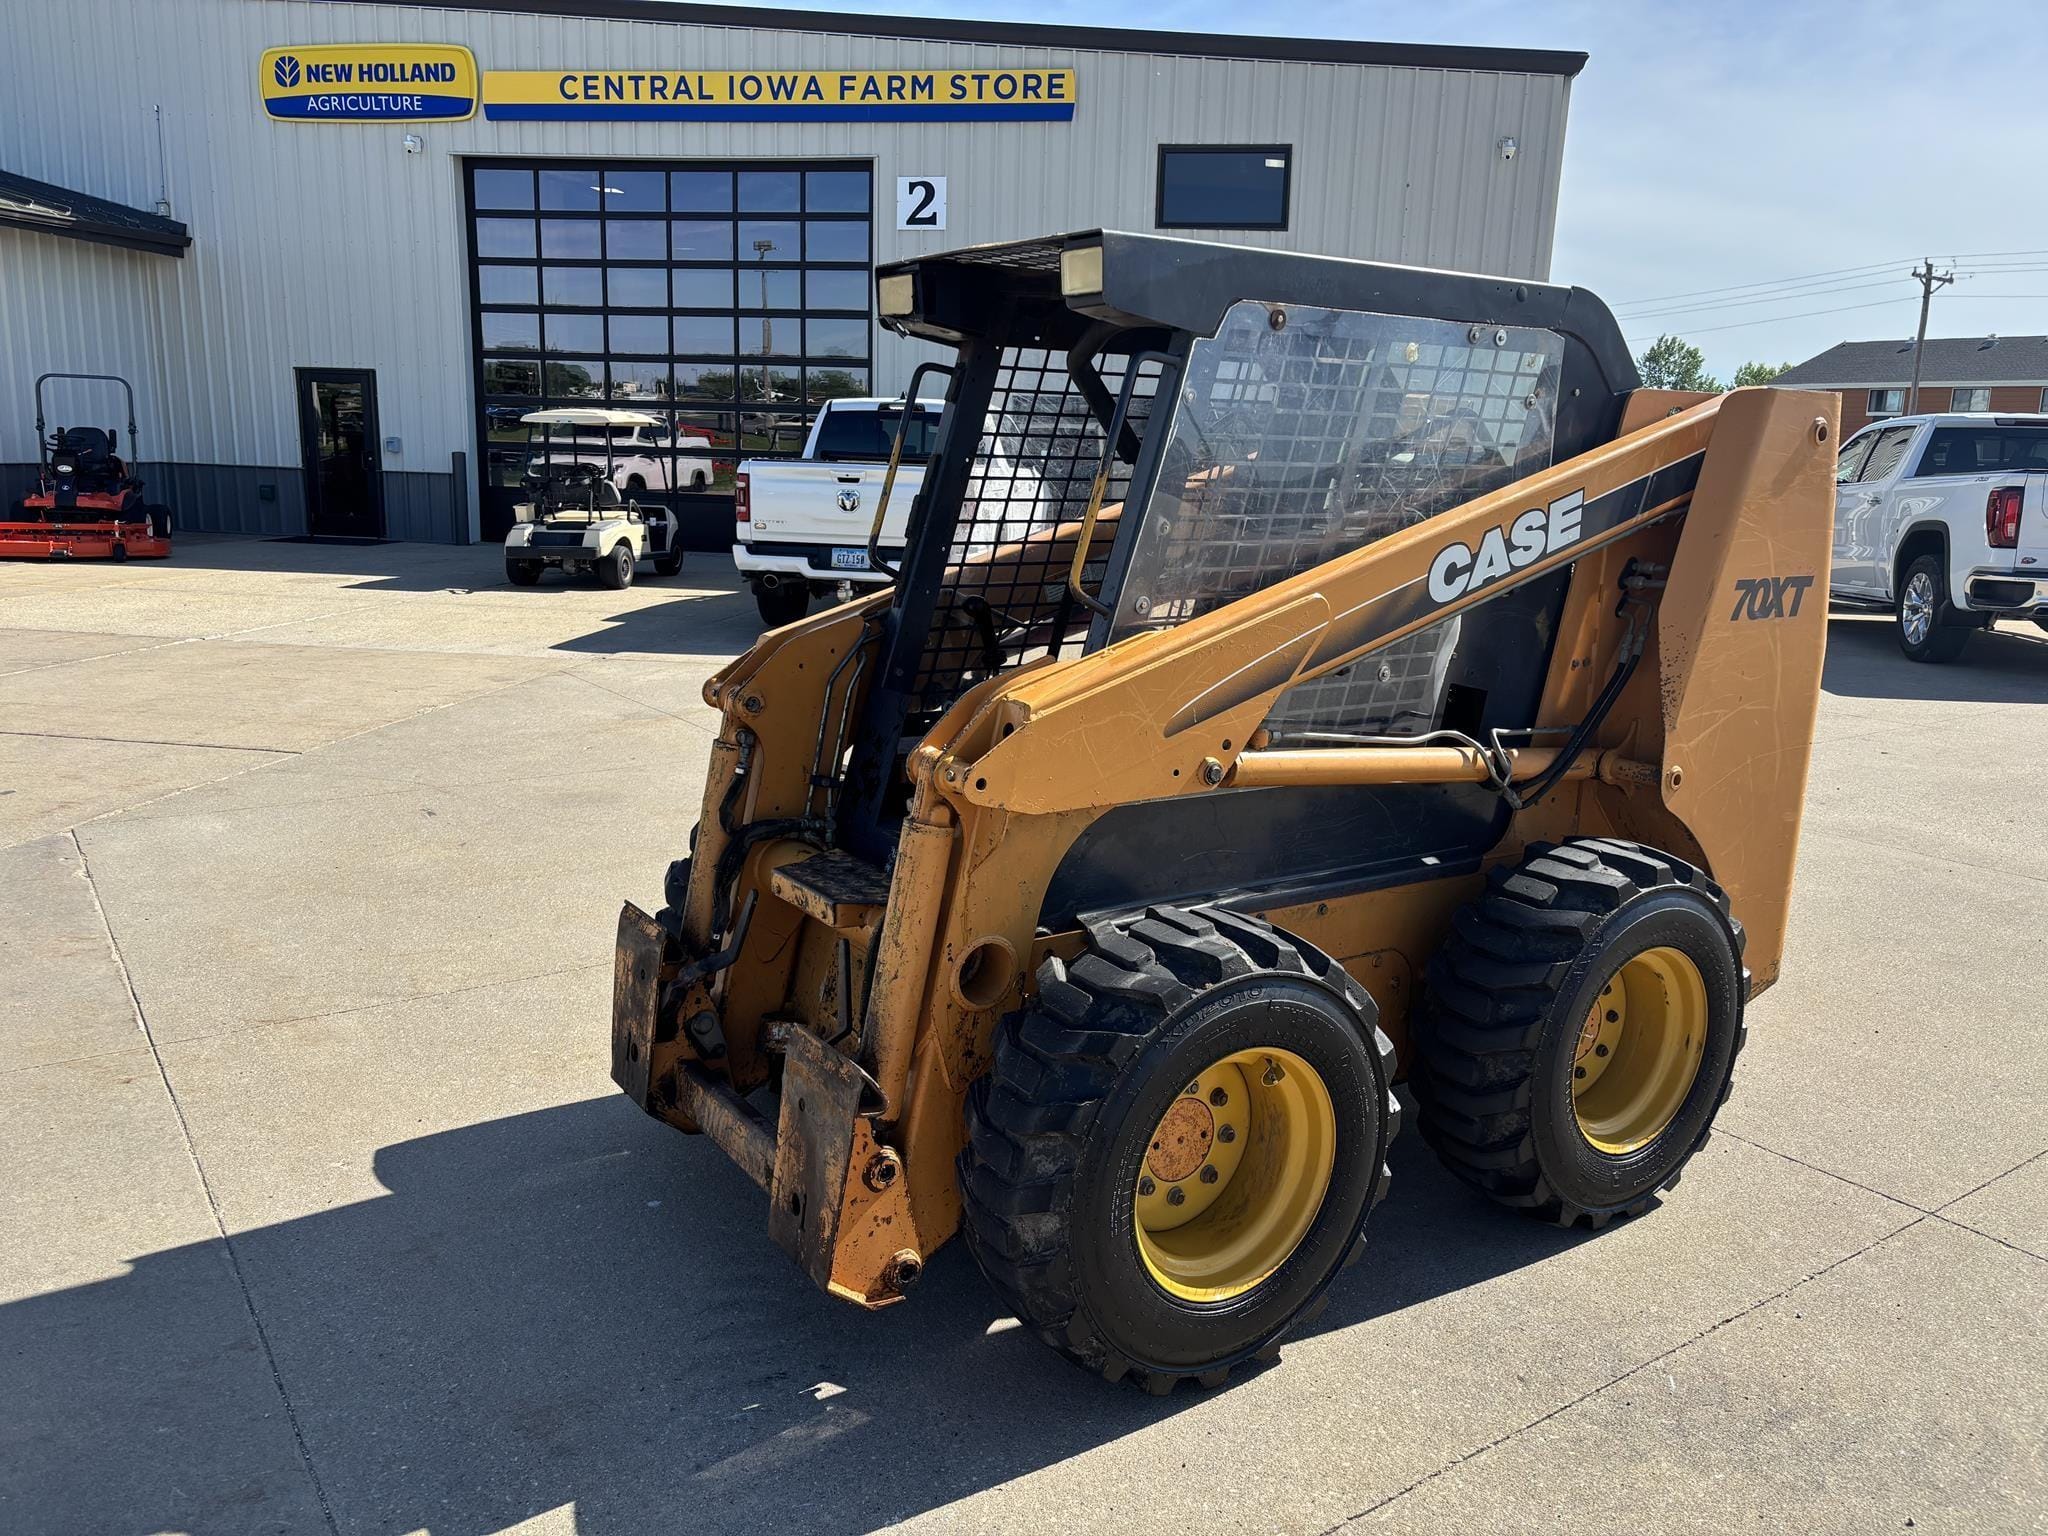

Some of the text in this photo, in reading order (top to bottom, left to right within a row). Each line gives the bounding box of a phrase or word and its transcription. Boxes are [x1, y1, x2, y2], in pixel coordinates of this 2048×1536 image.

[306, 63, 456, 83] NEW HOLLAND
[559, 73, 1066, 100] CENTRAL IOWA FARM STORE
[307, 95, 423, 111] AGRICULTURE
[906, 180, 937, 225] 2
[1427, 487, 1586, 604] CASE
[1730, 575, 1815, 622] 70XT
